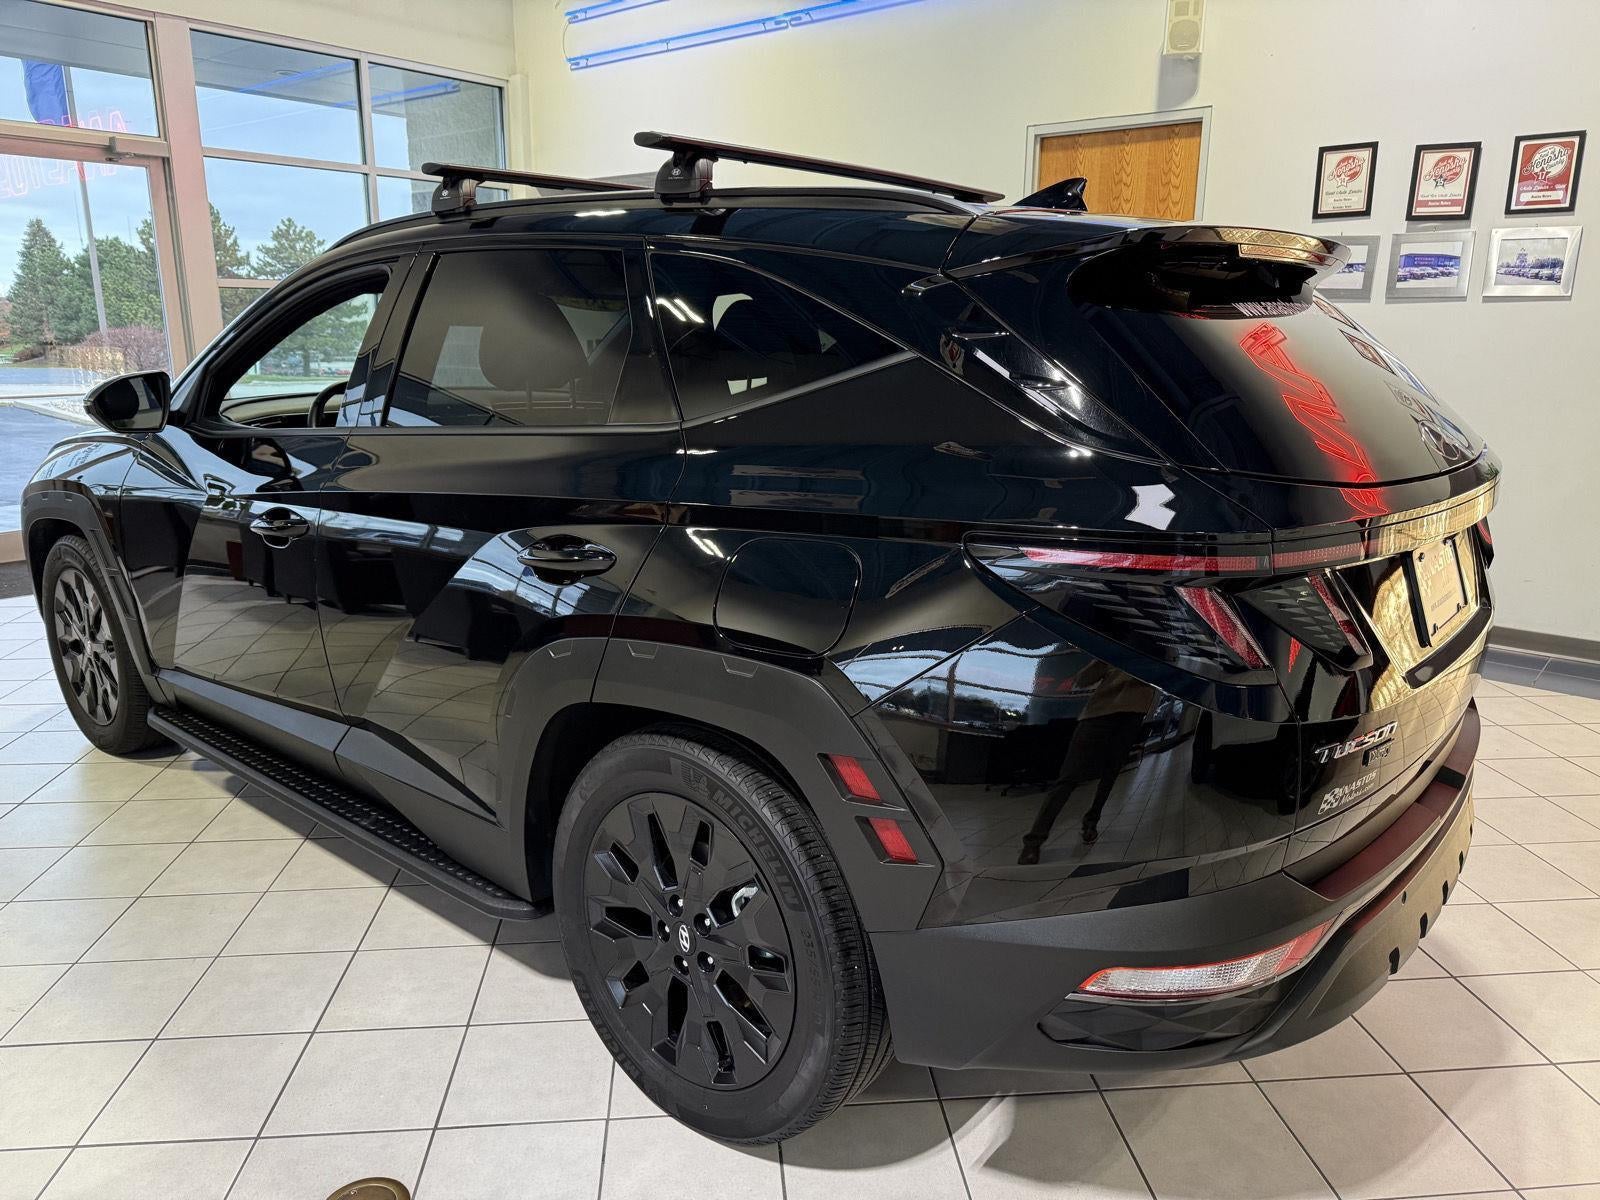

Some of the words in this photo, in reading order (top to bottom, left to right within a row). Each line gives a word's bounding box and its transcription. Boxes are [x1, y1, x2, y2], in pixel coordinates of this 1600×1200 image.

[1423, 157, 1467, 181] Kenosha
[1522, 147, 1572, 175] Kenosha
[1314, 720, 1398, 764] TUCSON
[711, 788, 803, 904] MICHELIN
